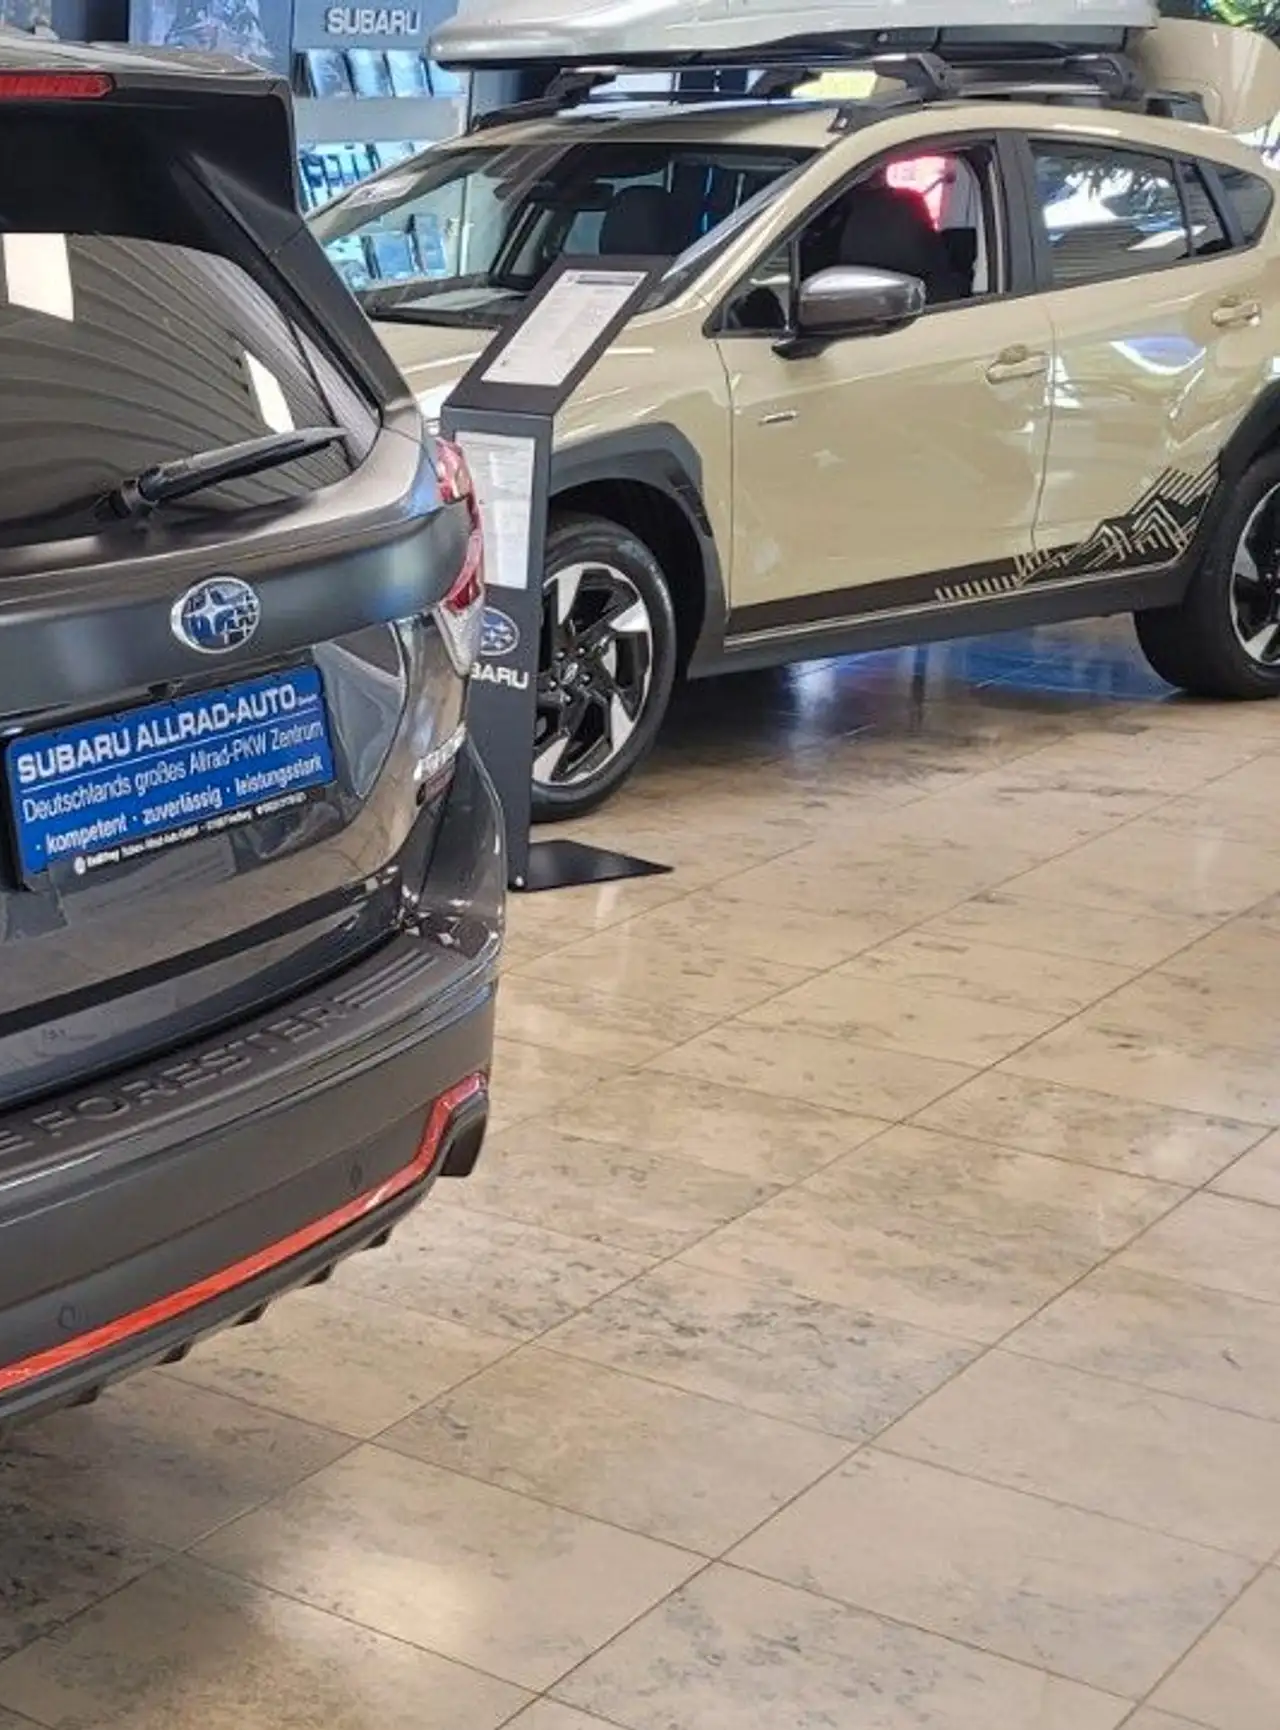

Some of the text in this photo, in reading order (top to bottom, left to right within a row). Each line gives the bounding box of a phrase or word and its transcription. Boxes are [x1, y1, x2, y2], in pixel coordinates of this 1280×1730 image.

[326, 7, 421, 36] SUBARU
[17, 683, 296, 784] SUBARU ALLRAD-AUTO
[22, 721, 324, 823] Deutschlands großes Allrad-PKW Zentrum
[45, 812, 128, 854] kompetent
[142, 784, 223, 826] zuverlässig
[233, 753, 324, 797] leistungsstark
[33, 1005, 348, 1138] FORESTER
